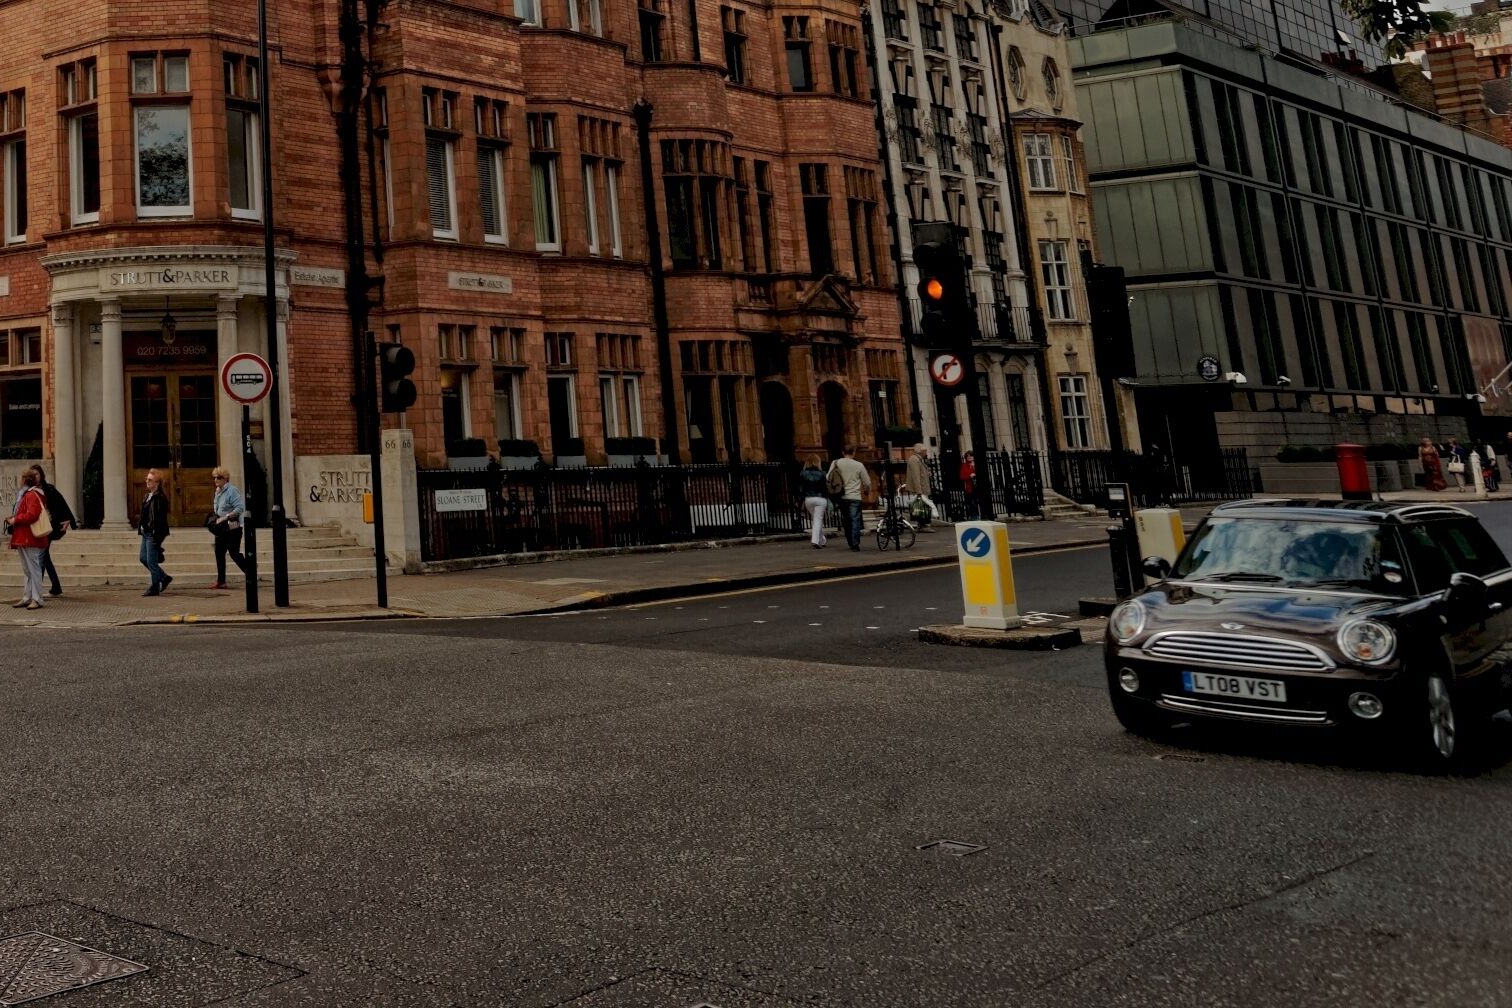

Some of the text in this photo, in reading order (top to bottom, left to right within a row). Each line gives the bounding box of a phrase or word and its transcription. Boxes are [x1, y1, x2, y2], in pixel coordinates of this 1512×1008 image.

[111, 268, 230, 285] STRUTT&PARKER
[137, 346, 155, 356] 020
[157, 345, 181, 356] 7235
[385, 439, 396, 449] 66
[319, 470, 372, 486] STRUTT
[437, 494, 484, 504] SLOANE STREET
[1194, 674, 1282, 698] LT08 VST
